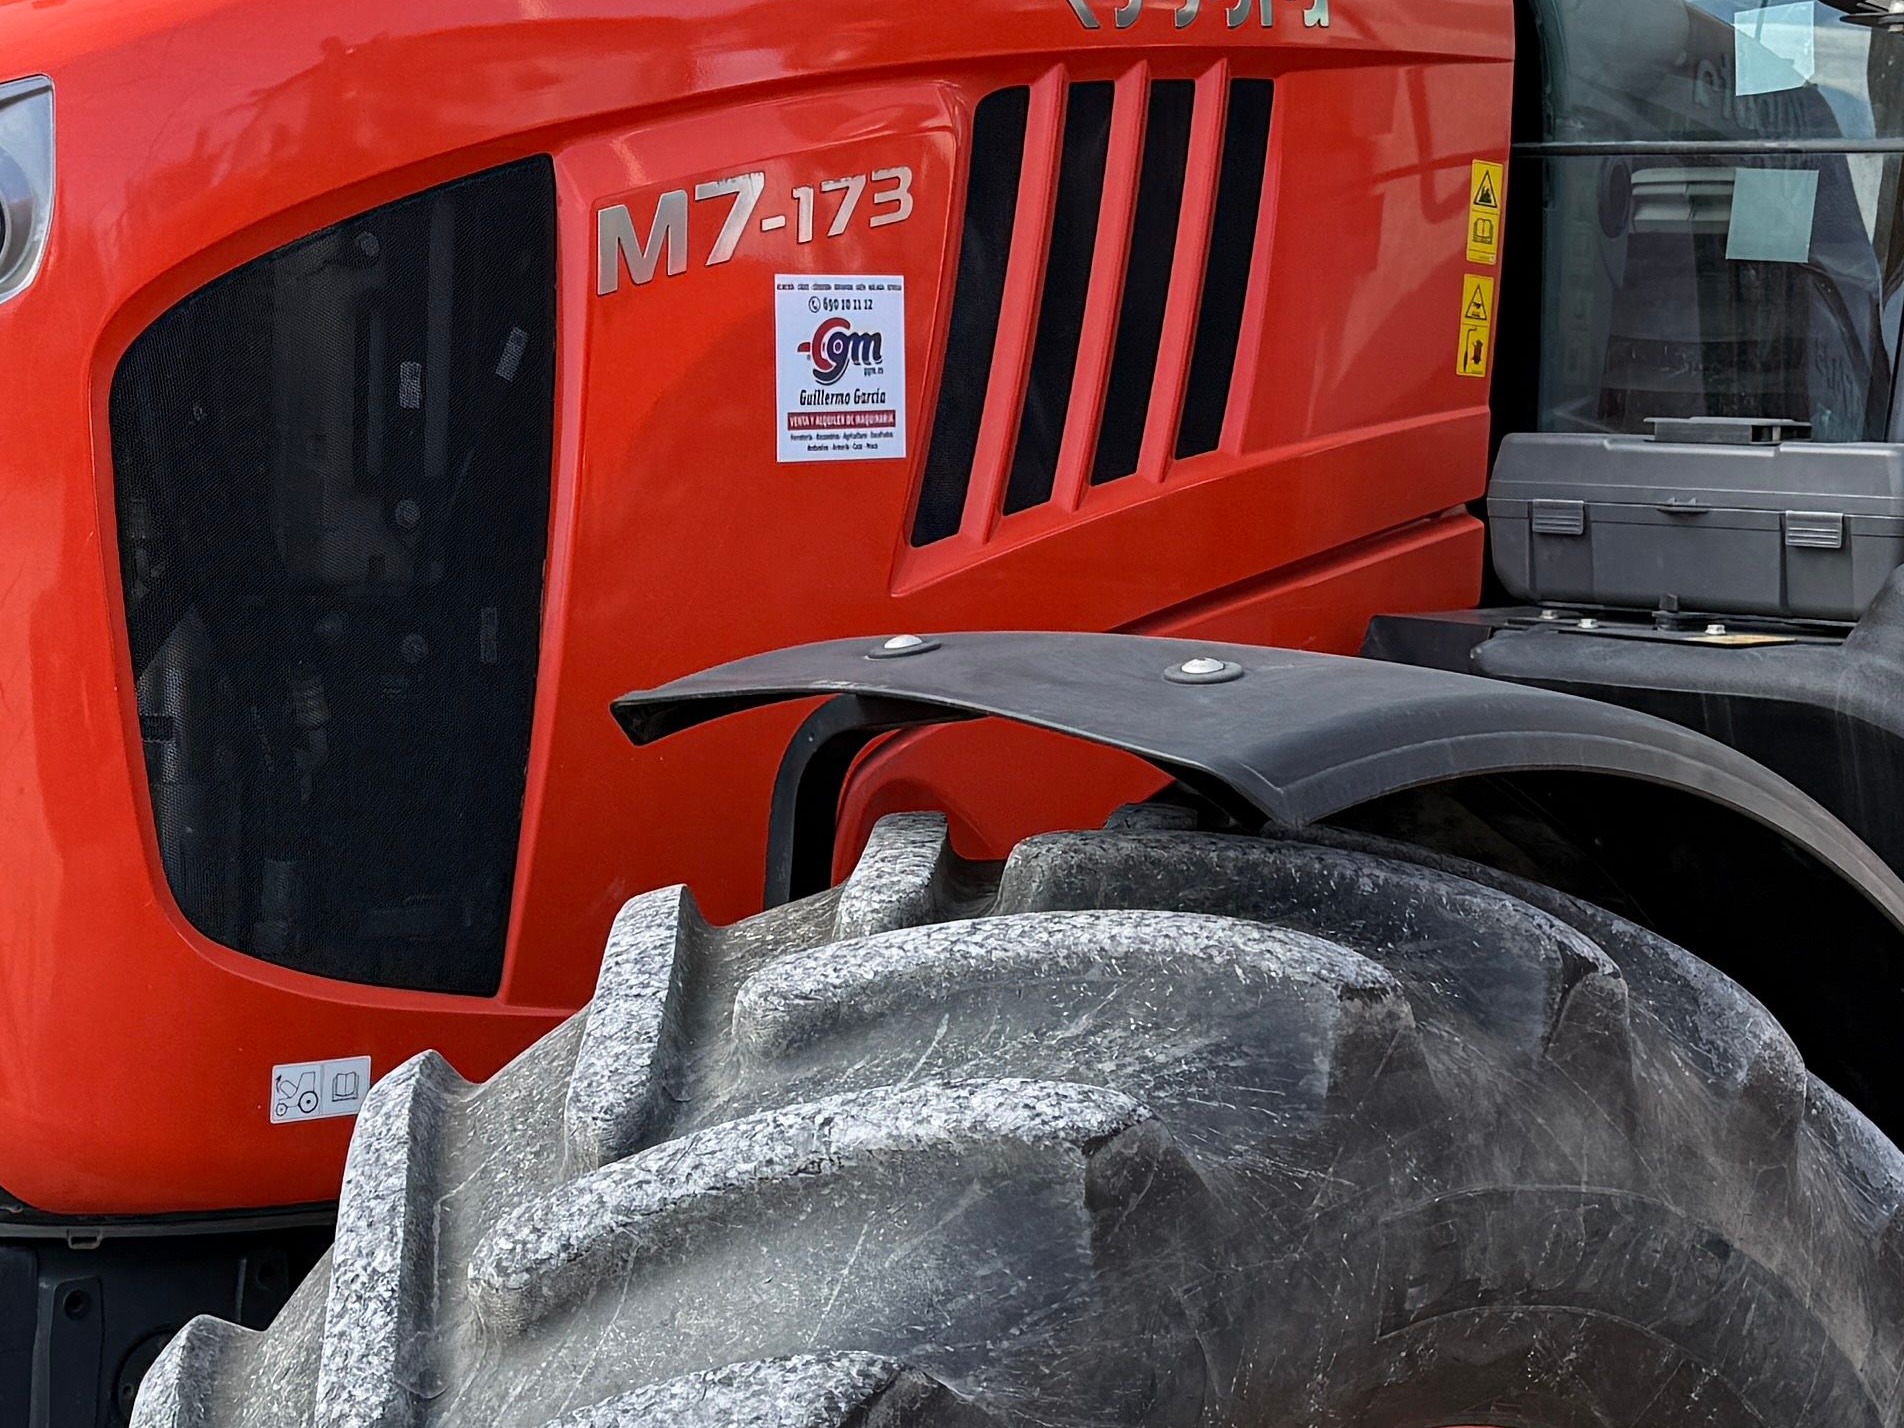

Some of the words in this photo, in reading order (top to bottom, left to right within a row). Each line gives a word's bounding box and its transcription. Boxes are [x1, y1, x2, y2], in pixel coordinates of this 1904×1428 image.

[597, 165, 914, 296] M7-173
[841, 298, 851, 311] 10
[853, 298, 862, 311] 11
[864, 298, 873, 310] 12
[799, 389, 851, 406] Guillermo
[854, 388, 886, 404] García
